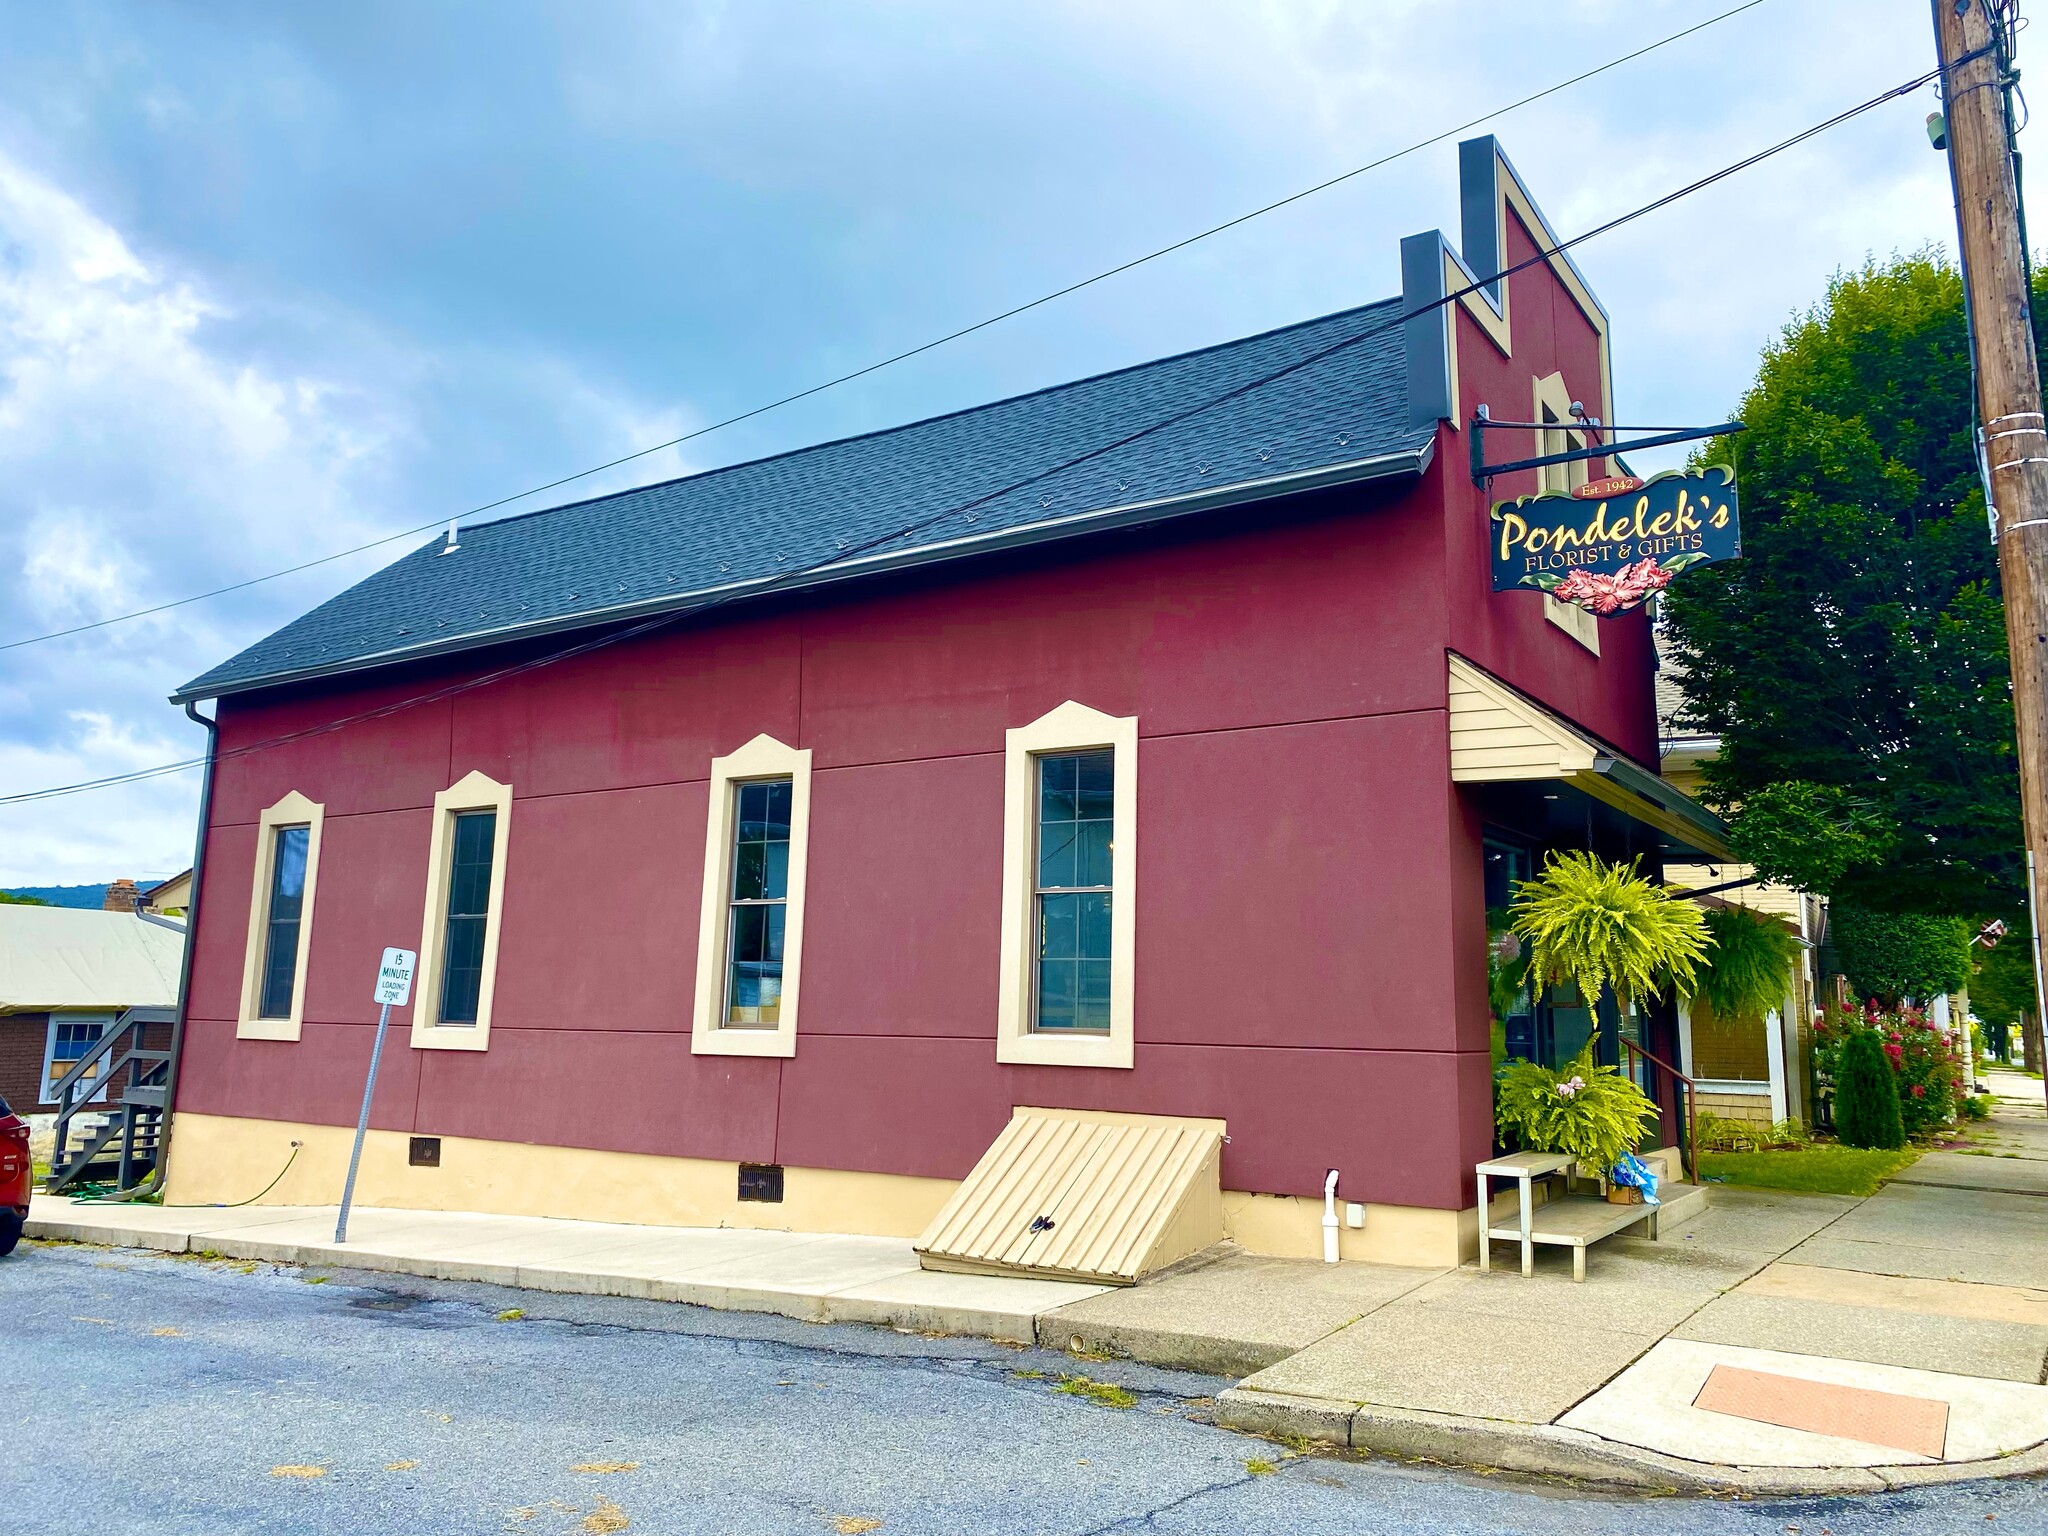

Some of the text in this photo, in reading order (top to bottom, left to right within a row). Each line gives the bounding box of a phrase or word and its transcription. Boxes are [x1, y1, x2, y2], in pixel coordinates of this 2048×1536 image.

[1581, 479, 1634, 497] Est. 1942
[1500, 489, 1730, 561] Pondelek's
[1525, 533, 1703, 572] FLORIST & GIFTS
[395, 953, 403, 965] 15
[382, 967, 410, 980] MINUTE
[382, 981, 405, 991] LOADING
[384, 990, 399, 999] ZONE
